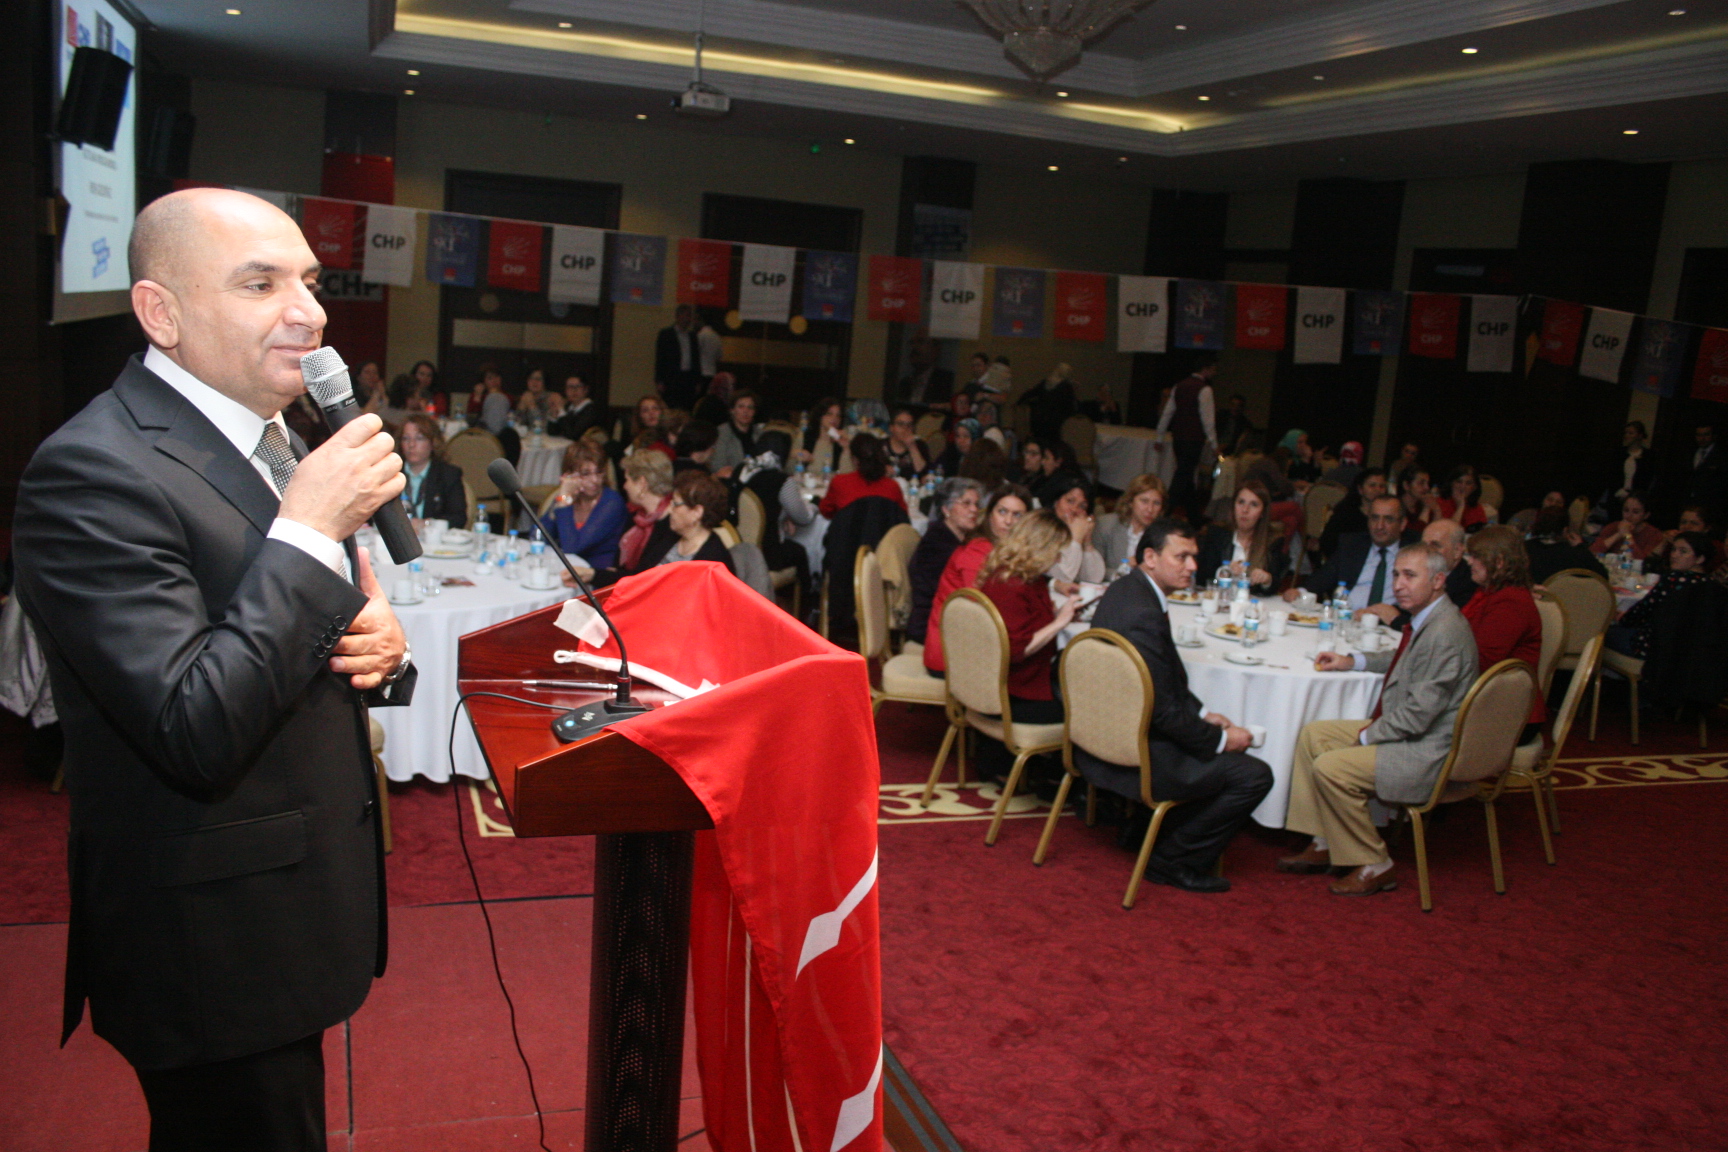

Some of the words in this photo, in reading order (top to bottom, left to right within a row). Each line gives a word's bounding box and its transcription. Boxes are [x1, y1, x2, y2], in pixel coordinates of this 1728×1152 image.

[372, 234, 405, 250] CHP
[561, 255, 595, 270] CHP
[752, 272, 786, 287] CHP
[941, 290, 974, 303] CHP
[1126, 303, 1158, 316] CHP
[1068, 315, 1090, 325] CHP
[1303, 314, 1335, 328] CHP
[1478, 322, 1509, 336] CHP
[1421, 334, 1442, 344] CHP
[1592, 334, 1619, 350] CHP
